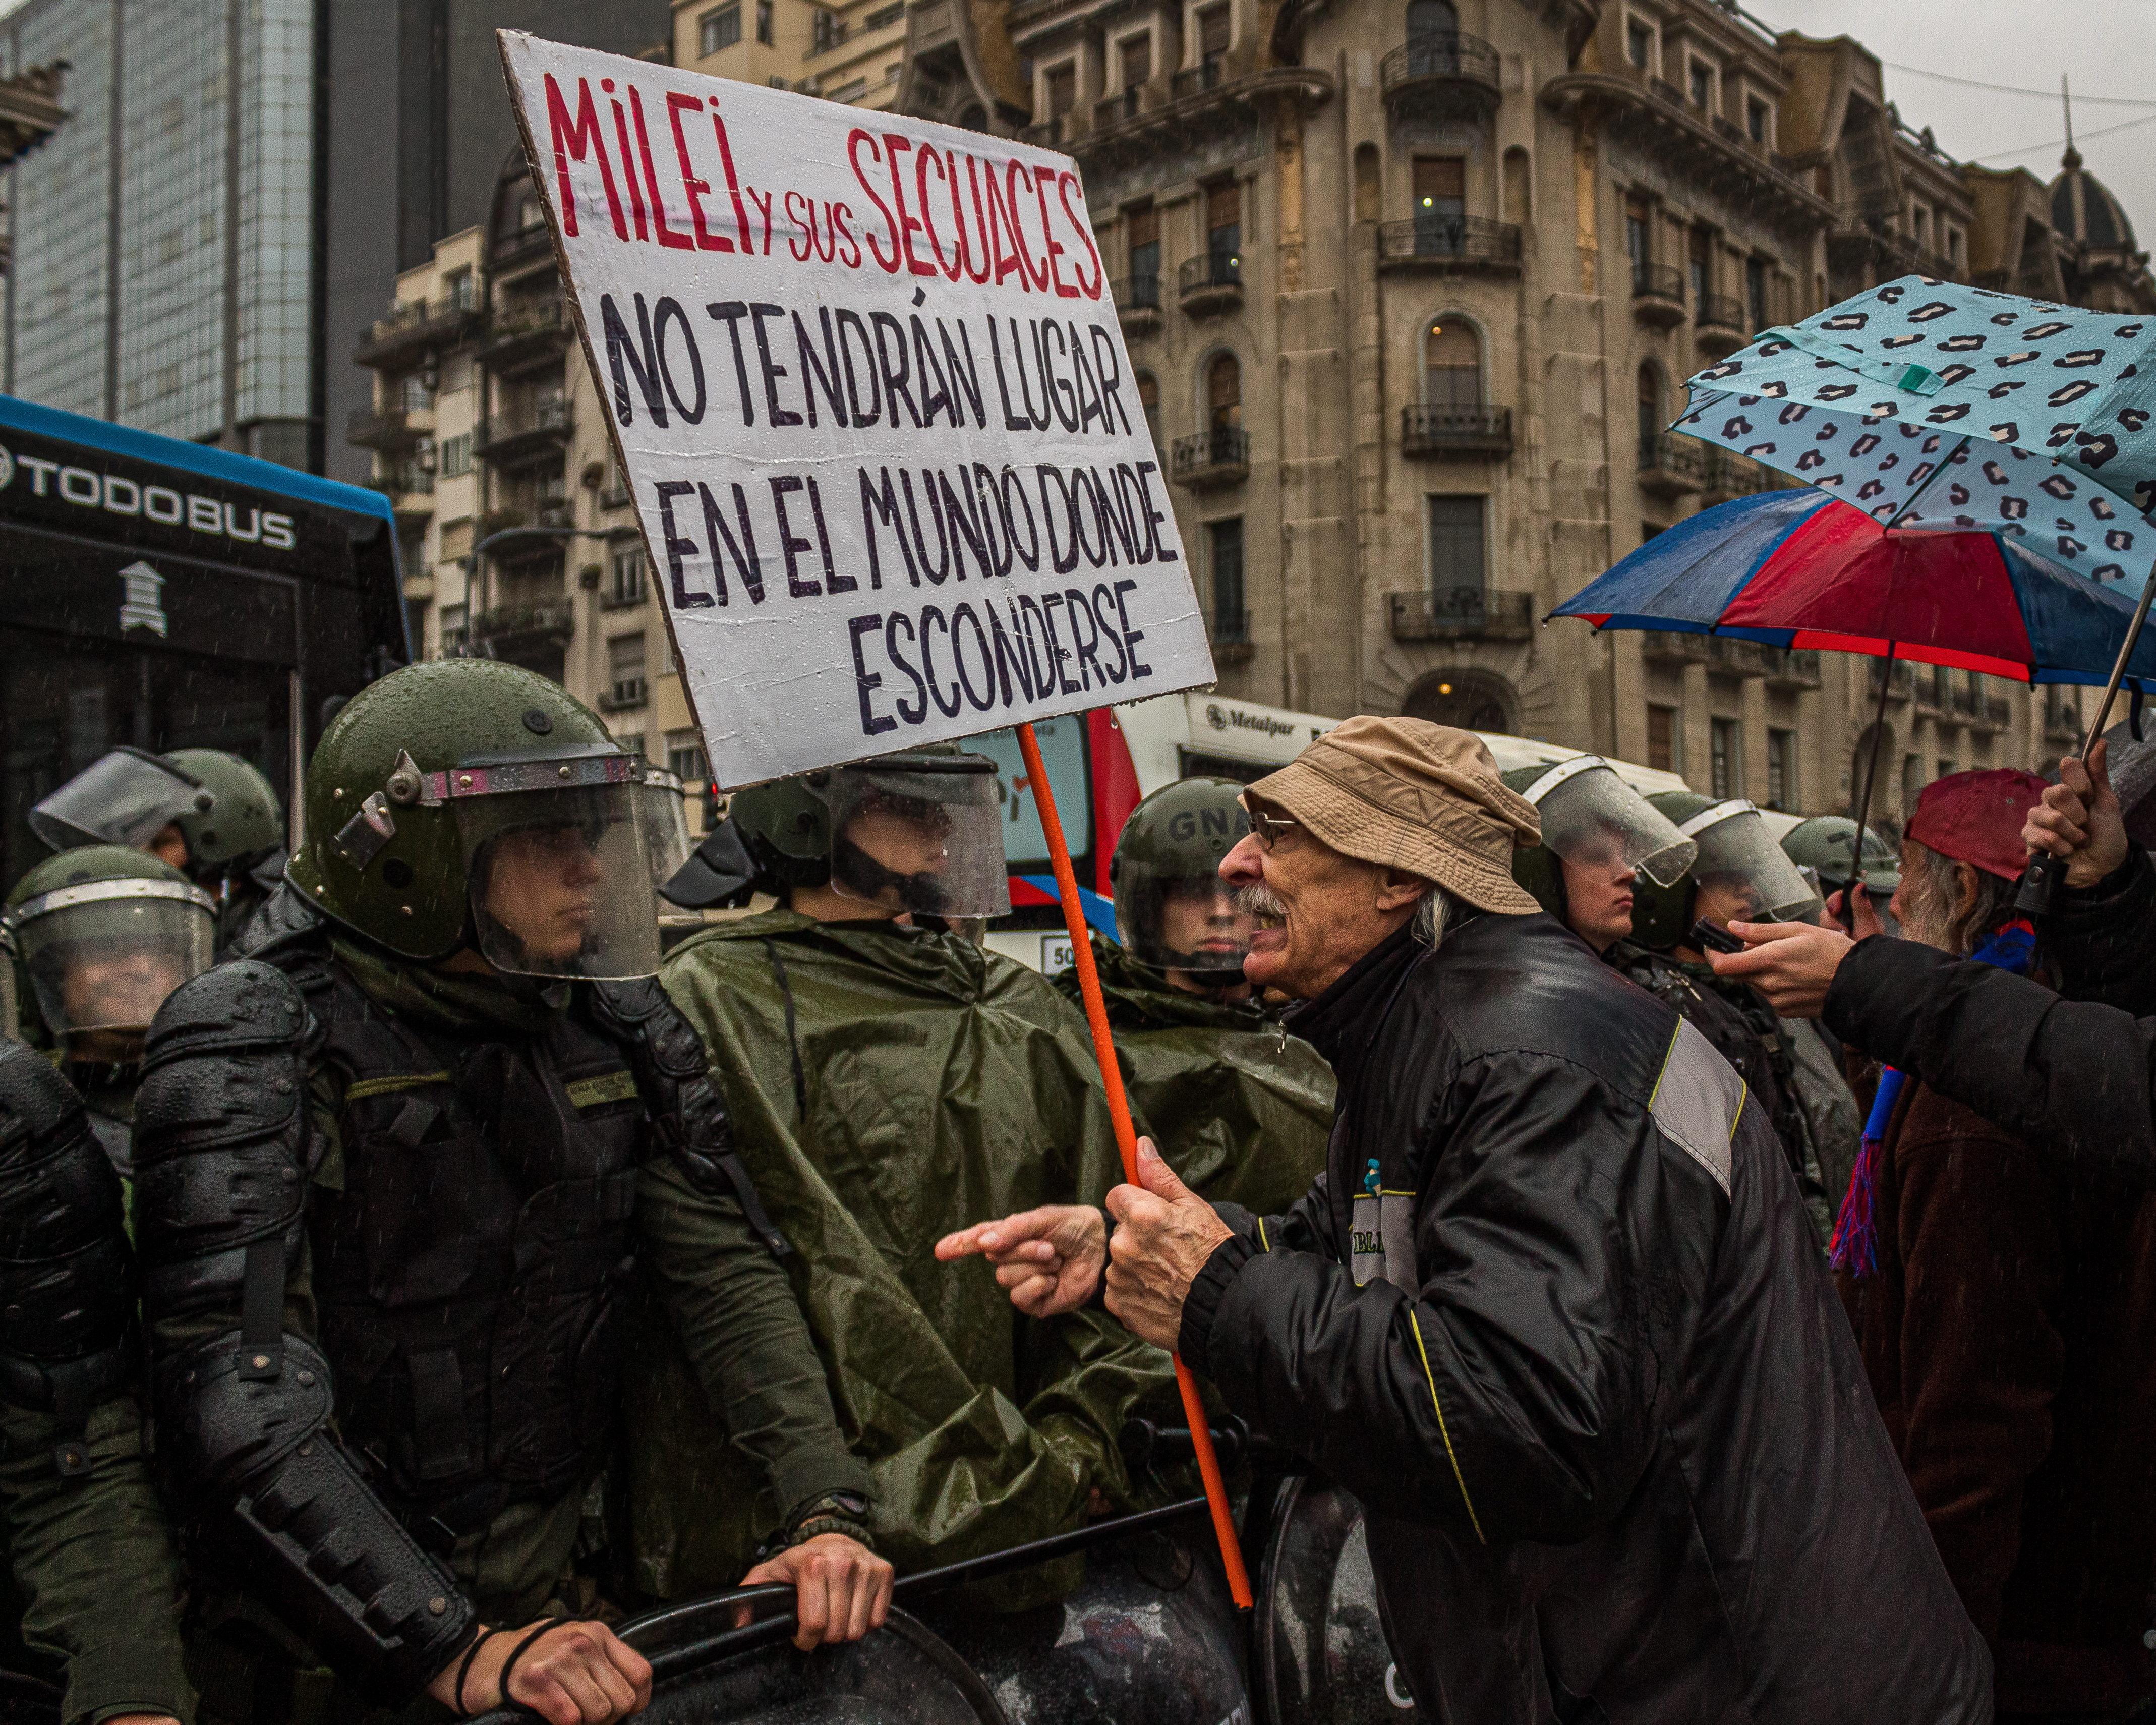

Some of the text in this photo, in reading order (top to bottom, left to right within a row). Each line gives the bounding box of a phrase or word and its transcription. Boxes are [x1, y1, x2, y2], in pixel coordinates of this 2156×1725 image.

[847, 127, 1102, 301] SECUACES
[601, 286, 1132, 436] NO TENDRÁN LUGAR
[17, 454, 297, 551] TODOBUS
[653, 459, 1178, 610] EN EL MUNDO DONDE
[848, 579, 1152, 736] ESCONDERSE
[1230, 709, 1295, 738] Metalpar
